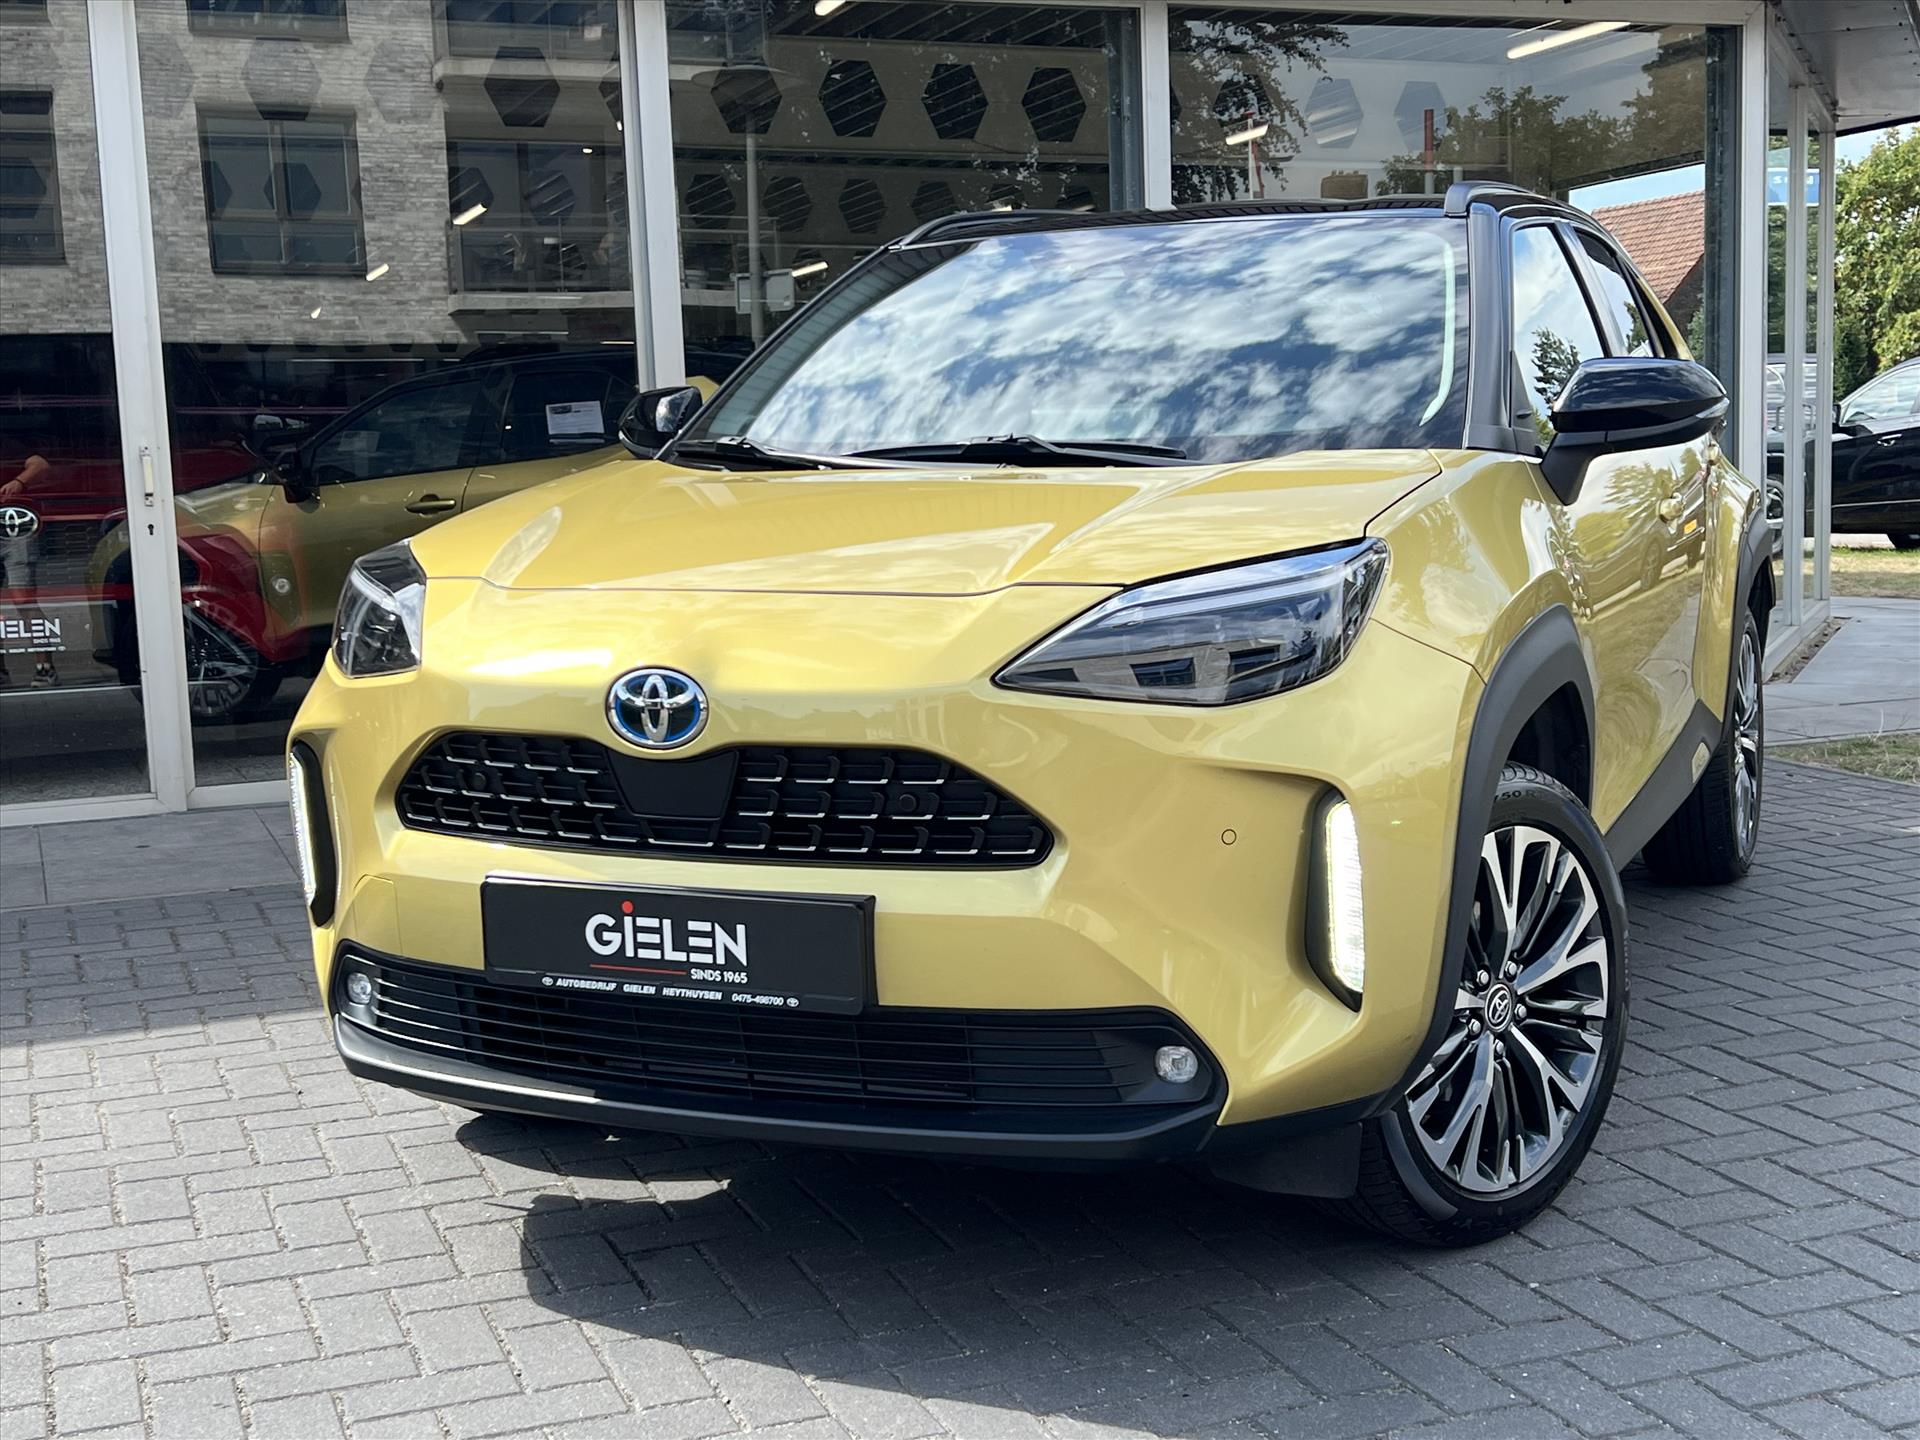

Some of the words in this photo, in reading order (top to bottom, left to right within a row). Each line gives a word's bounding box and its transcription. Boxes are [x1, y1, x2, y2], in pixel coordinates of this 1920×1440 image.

[690, 968, 722, 982] SINDS
[723, 971, 748, 984] 1965
[556, 978, 617, 992] AUTOBEDRIJF
[623, 984, 656, 994] GIELEN
[662, 987, 723, 1001] HEYTHUYSEN
